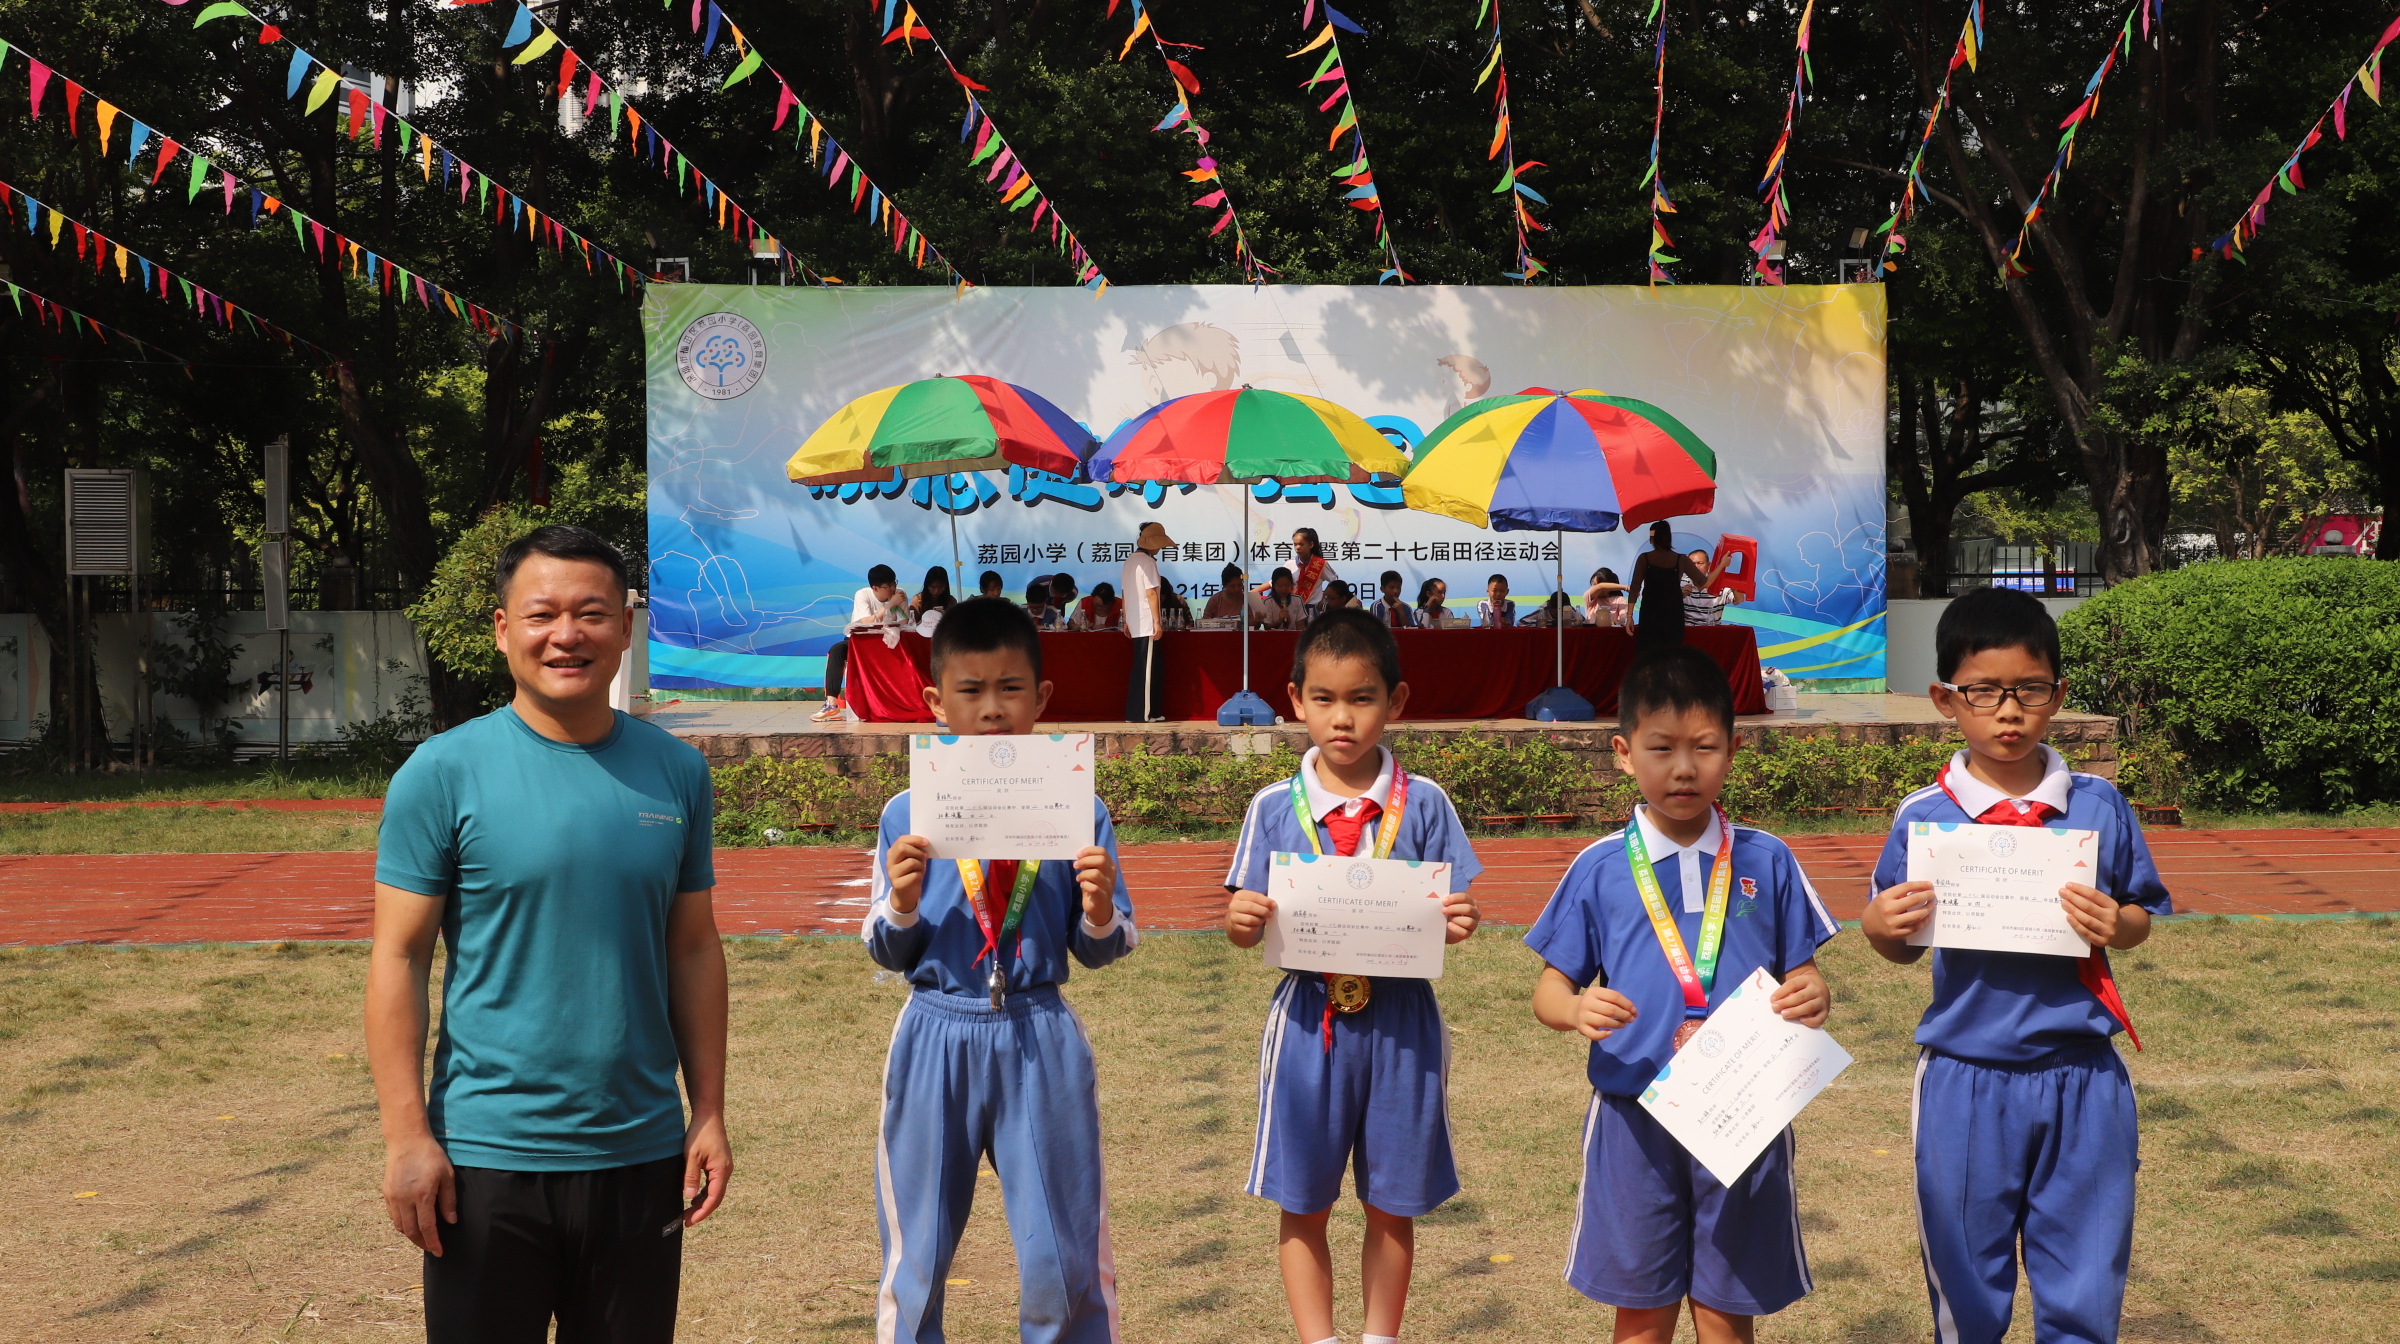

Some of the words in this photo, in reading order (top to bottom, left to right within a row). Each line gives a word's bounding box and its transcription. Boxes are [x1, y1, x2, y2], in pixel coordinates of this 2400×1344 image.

[712, 388, 732, 396] 1981
[977, 540, 1560, 565] 荔园小学（荔园育集团）体育暨第二十七届田径运动会
[961, 777, 1007, 786] CERTIFICATE
[1008, 777, 1020, 785] OF
[1020, 777, 1044, 785] MERIT
[638, 812, 674, 822] TRAINING
[1960, 865, 2007, 875] CERTIFICATE
[2008, 867, 2019, 875] OF
[2020, 868, 2044, 877] MERIT
[1318, 896, 1363, 906] CERTIFICATE
[1364, 899, 1374, 907] OF
[1375, 900, 1398, 908] MERIT
[1702, 1057, 1736, 1095] CERTIFICATE
[1733, 1048, 1744, 1059] OF
[1742, 1030, 1761, 1051] MERIT
